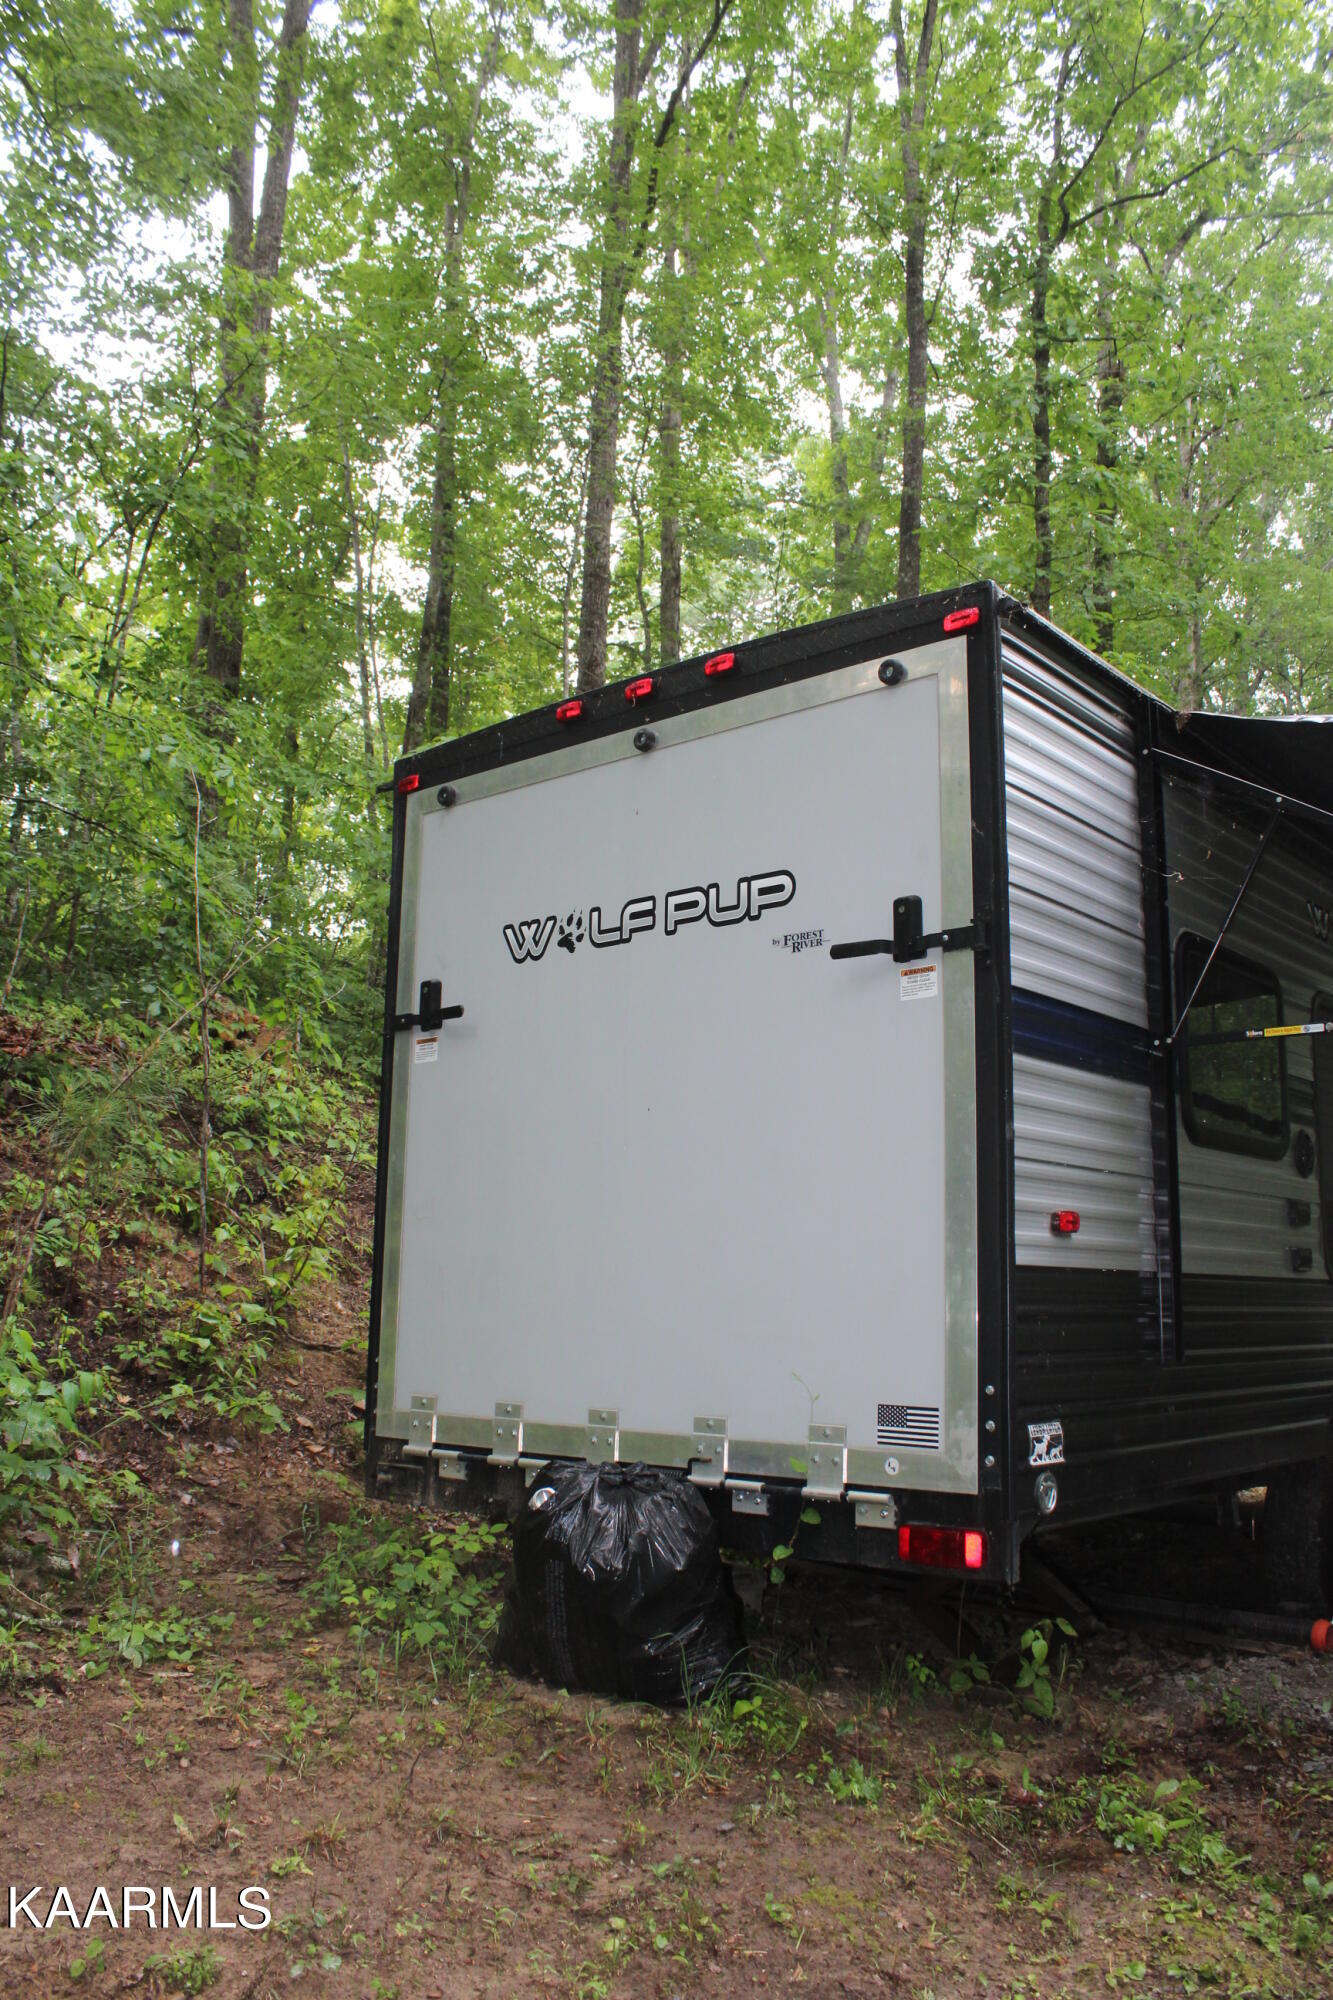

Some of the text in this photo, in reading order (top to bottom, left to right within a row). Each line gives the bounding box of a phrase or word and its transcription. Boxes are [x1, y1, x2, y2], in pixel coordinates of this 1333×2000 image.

[665, 869, 796, 936] PUP
[772, 929, 824, 946] by FOREST
[792, 939, 823, 953] RIVER
